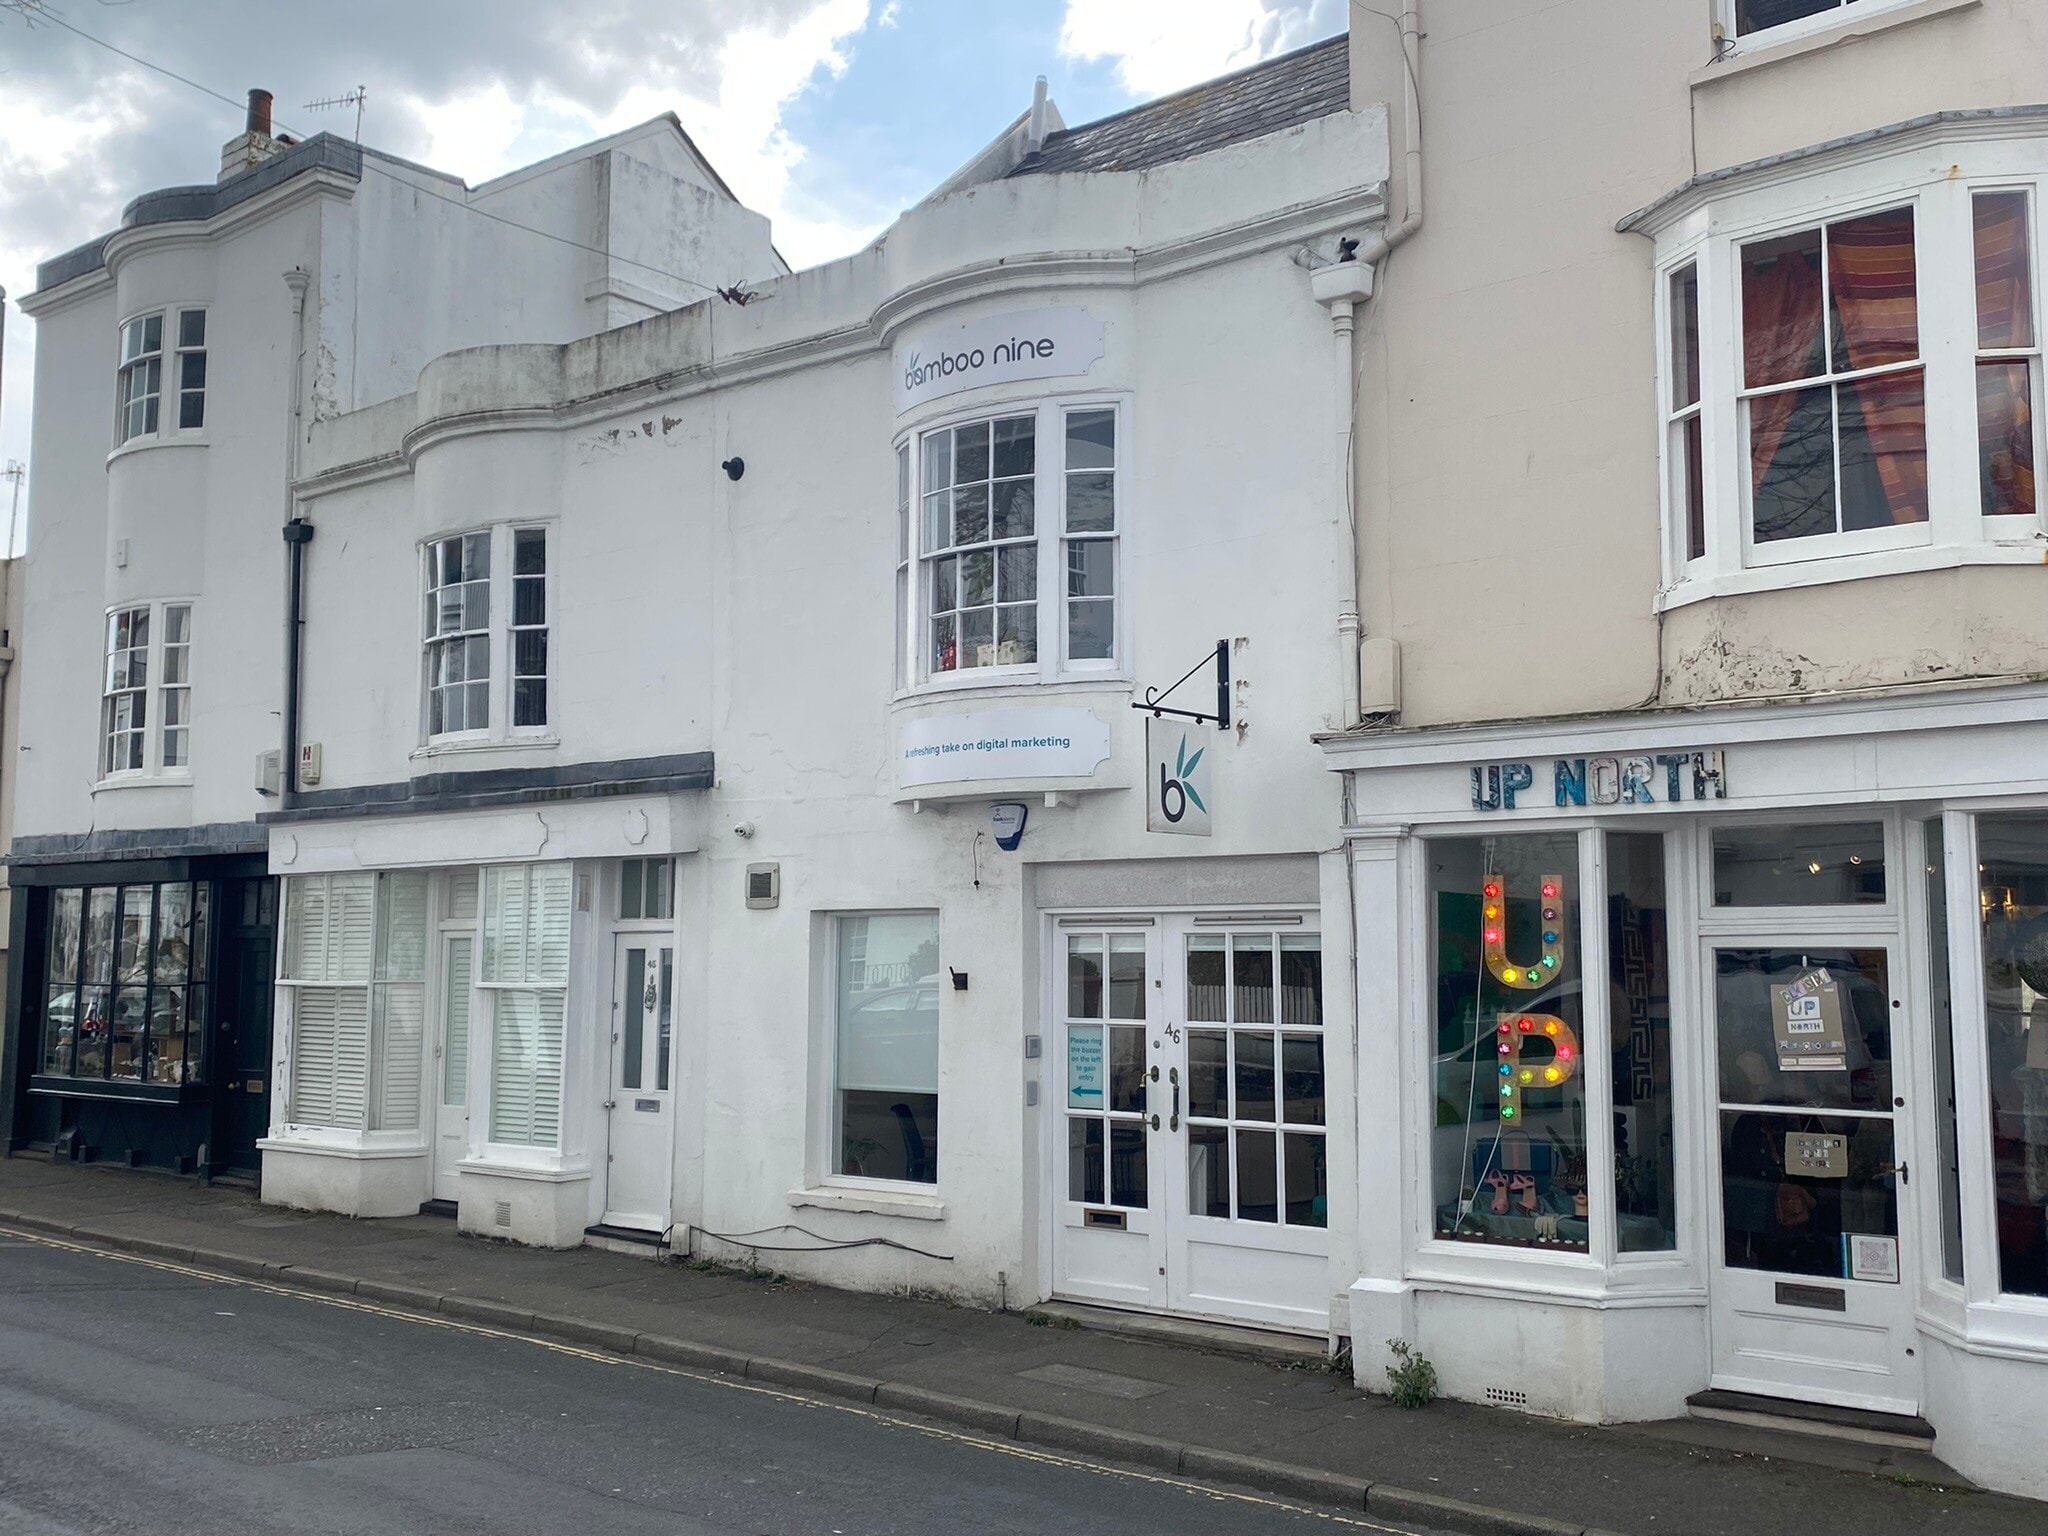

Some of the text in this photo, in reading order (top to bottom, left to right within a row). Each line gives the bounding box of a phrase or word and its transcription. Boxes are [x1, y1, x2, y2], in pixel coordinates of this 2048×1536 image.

[905, 337, 1055, 390] bamboo nine
[942, 743, 960, 753] take
[976, 738, 1008, 751] digital
[1011, 736, 1070, 748] marketing
[1470, 750, 1727, 811] UP NORTH
[1790, 1001, 1816, 1016] UP
[1164, 1022, 1180, 1044] 46
[1790, 1022, 1820, 1031] NORTH
[1078, 1075, 1094, 1083] entry
